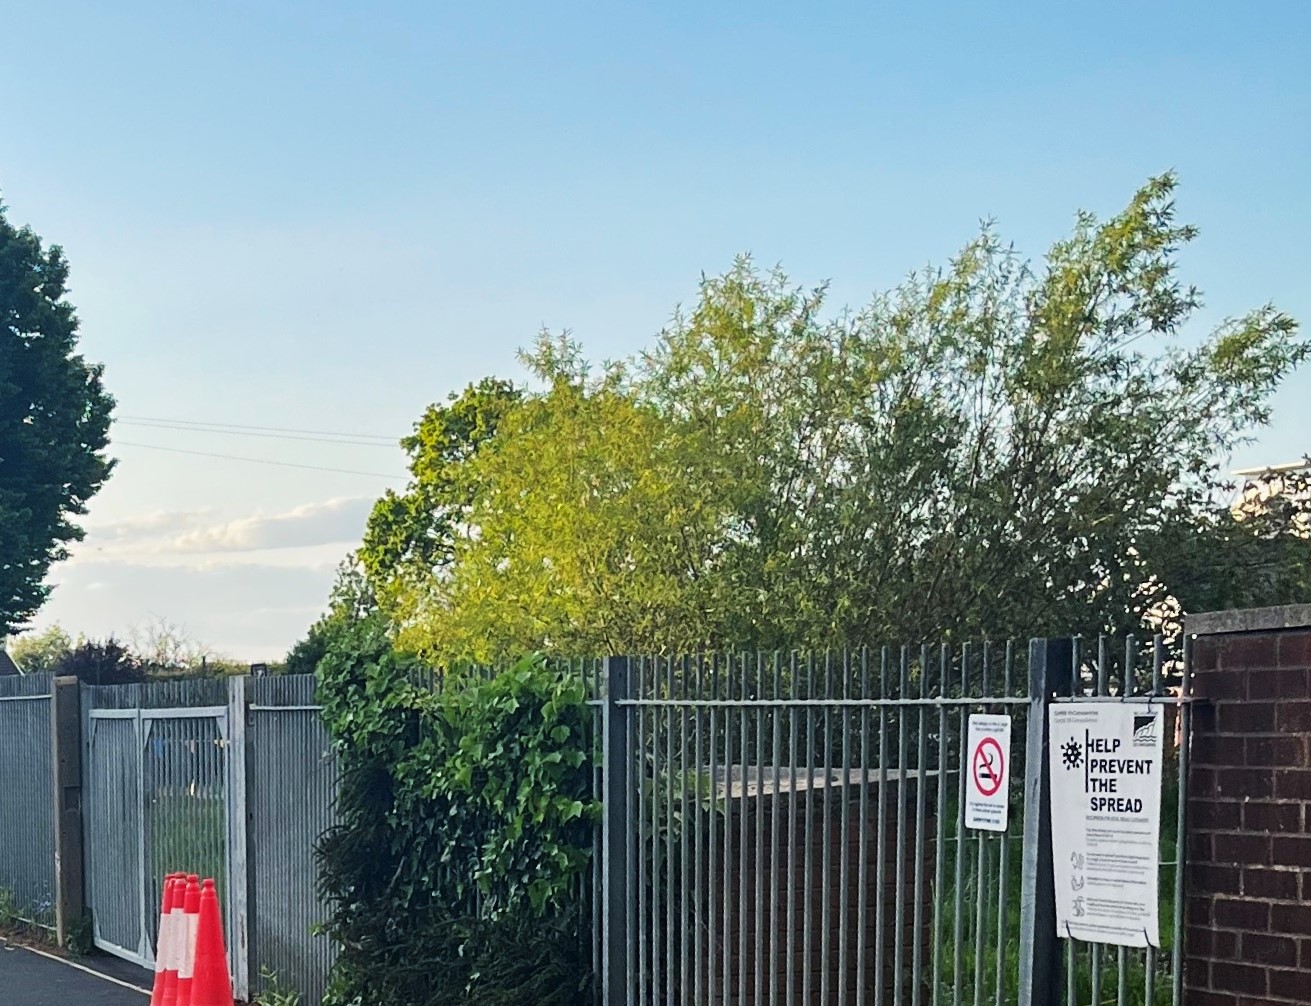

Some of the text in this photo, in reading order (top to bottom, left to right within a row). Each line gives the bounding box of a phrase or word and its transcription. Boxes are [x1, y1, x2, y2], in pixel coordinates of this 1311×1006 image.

[1087, 738, 1121, 754] HELP
[1090, 758, 1153, 775] PREVENT
[1090, 778, 1118, 793] THE
[1090, 797, 1143, 813] SPREAD
